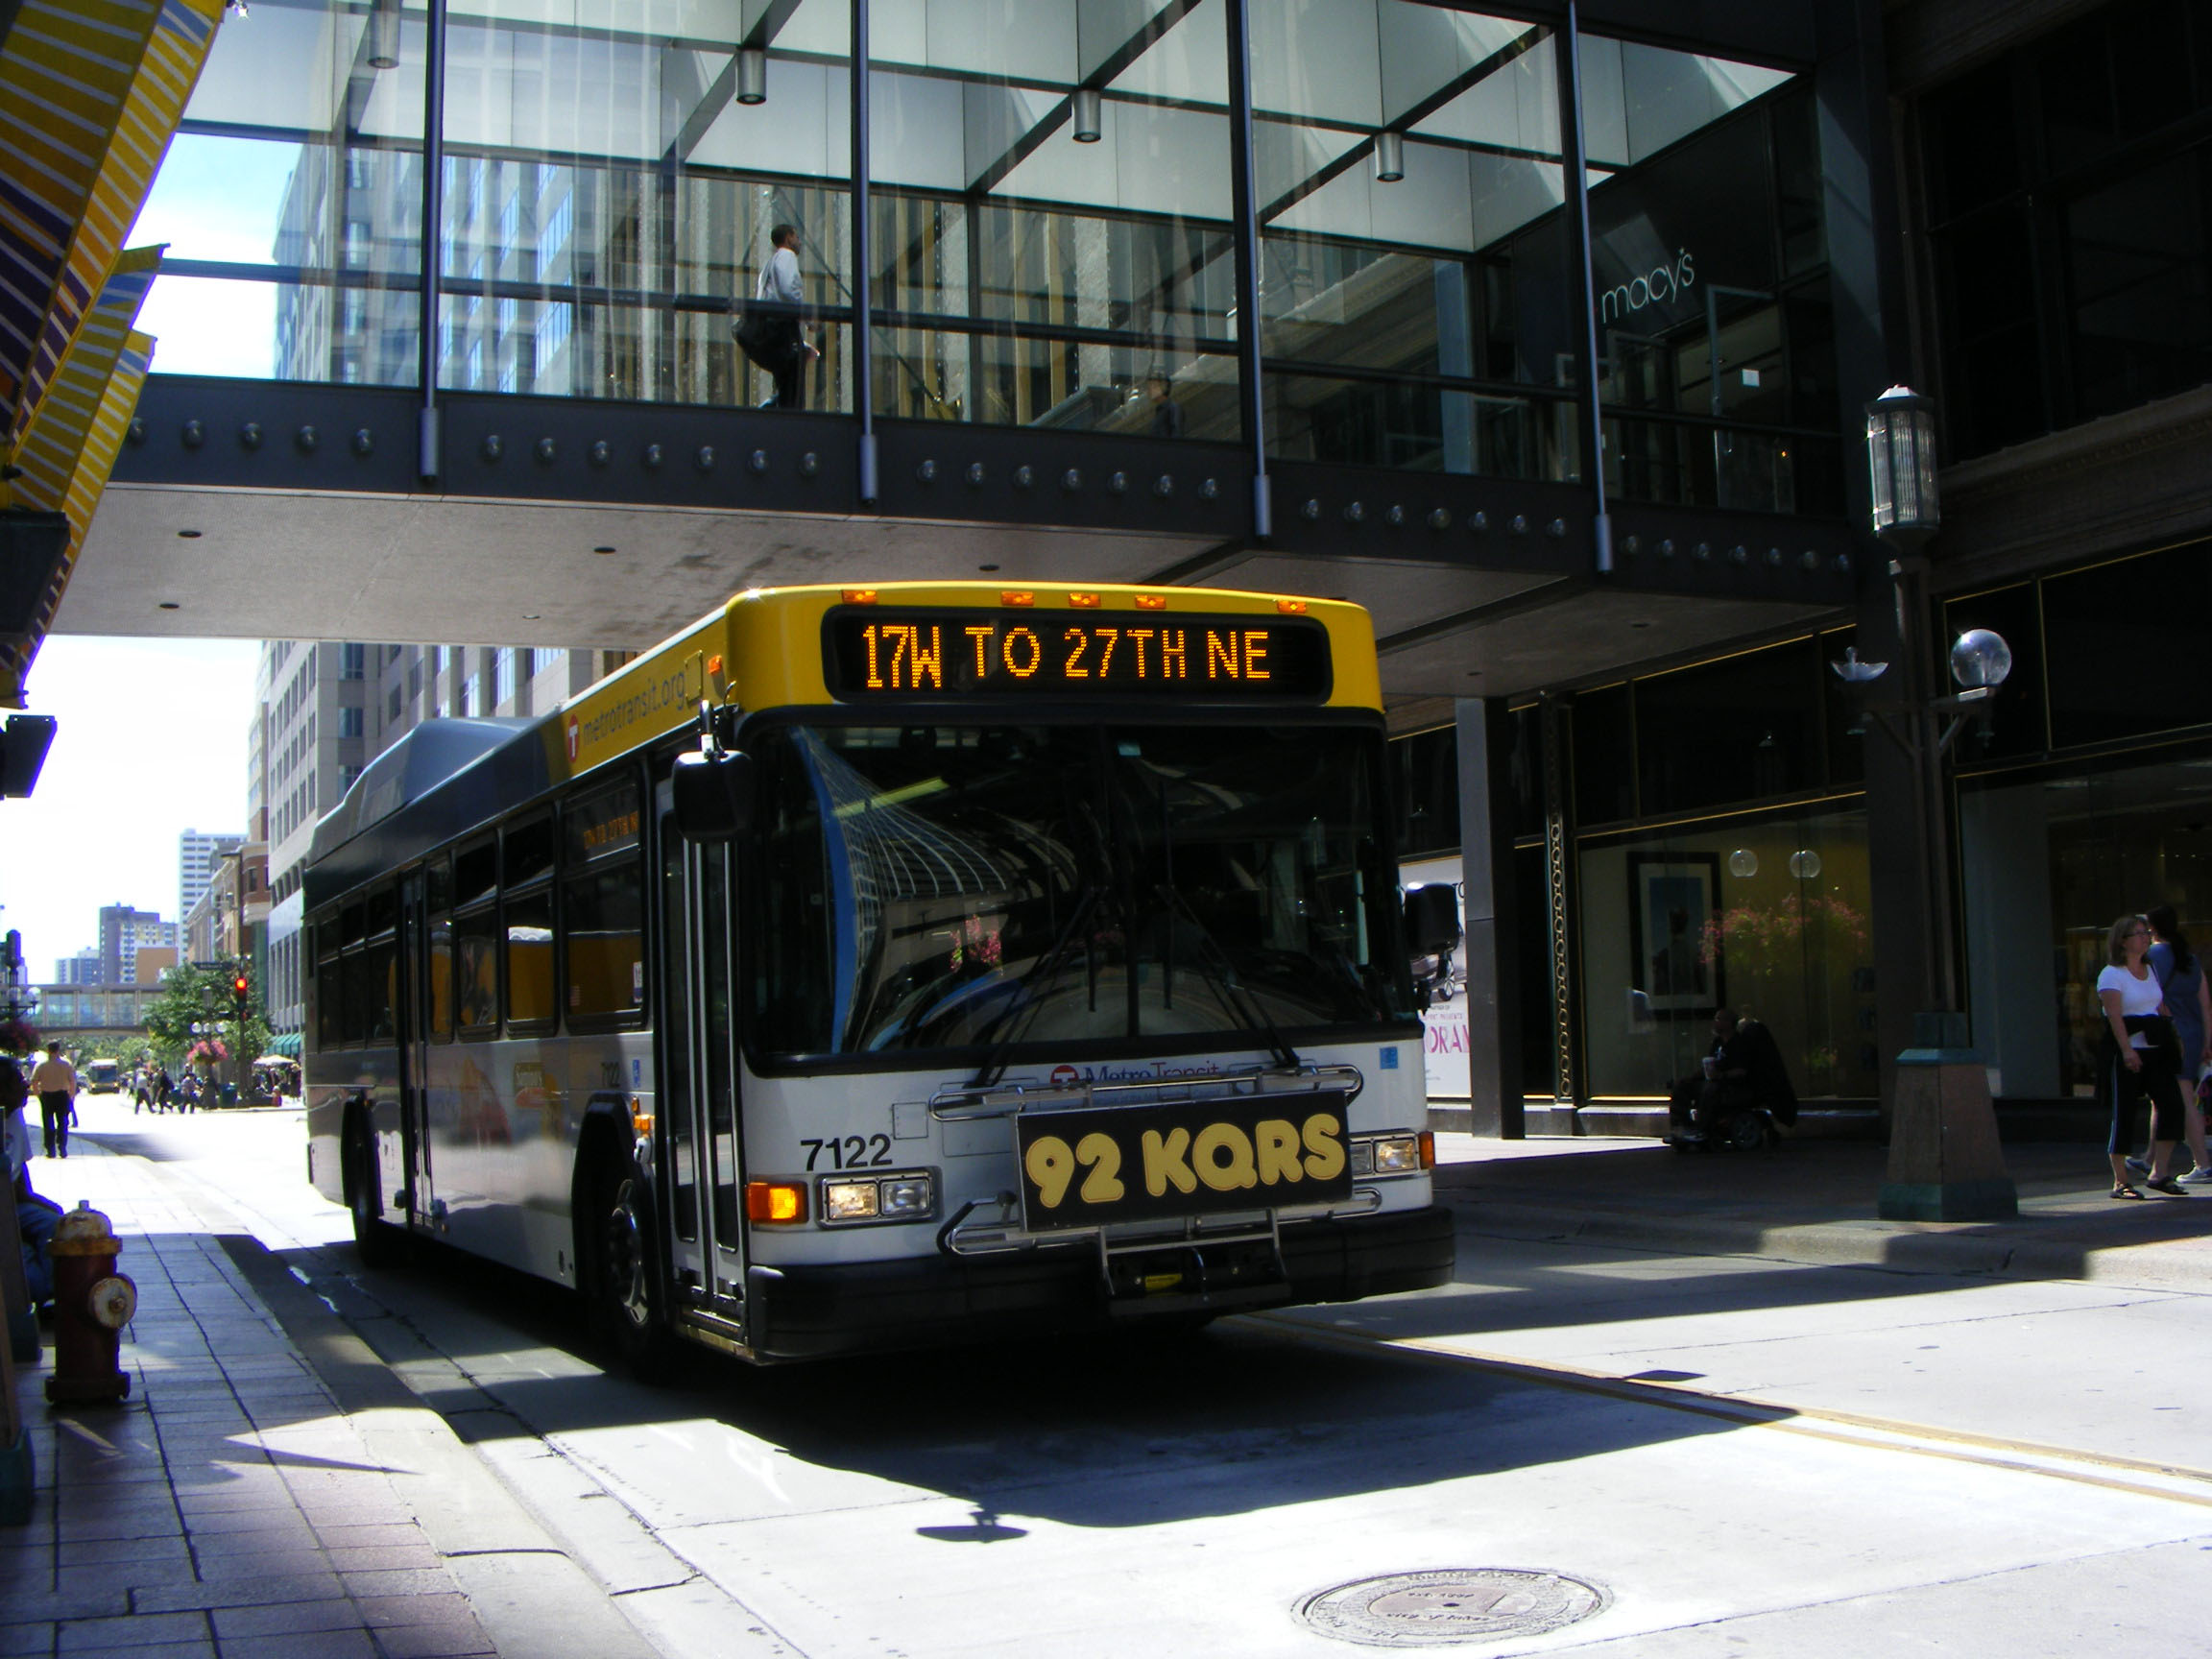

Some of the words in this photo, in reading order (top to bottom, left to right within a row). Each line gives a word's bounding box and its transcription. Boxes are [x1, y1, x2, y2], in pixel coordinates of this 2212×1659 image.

[1601, 247, 1695, 324] macy's
[862, 625, 943, 690] 17W
[965, 627, 1042, 679] TO
[1064, 628, 1187, 681] 27TH
[1208, 630, 1271, 681] NE
[583, 671, 685, 745] metrotransit.org
[801, 1133, 893, 1171] 7122
[1025, 1132, 1125, 1210] 92
[1143, 1112, 1347, 1198] KQRS
